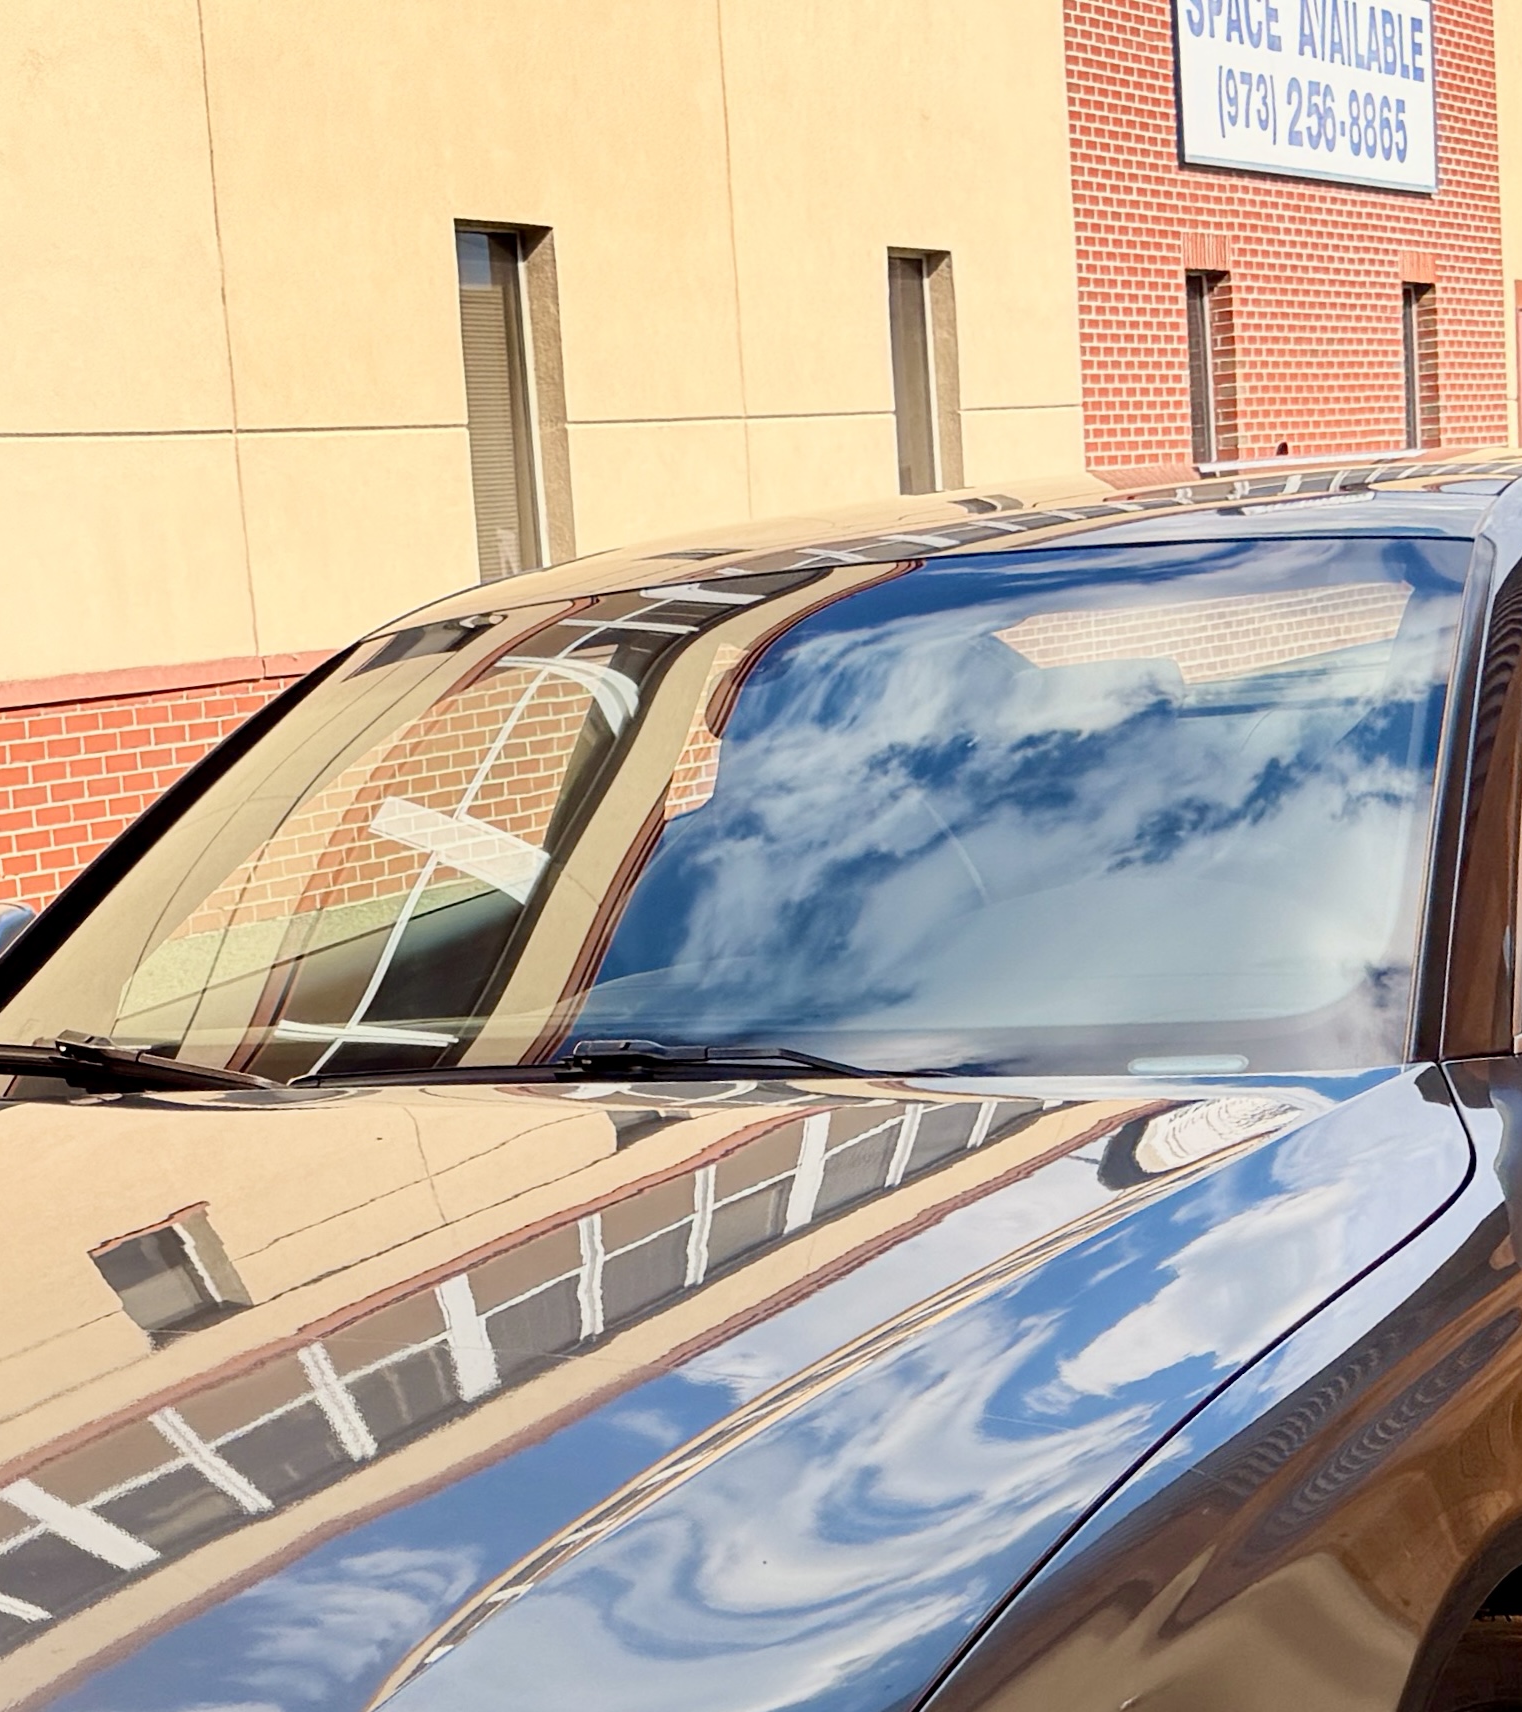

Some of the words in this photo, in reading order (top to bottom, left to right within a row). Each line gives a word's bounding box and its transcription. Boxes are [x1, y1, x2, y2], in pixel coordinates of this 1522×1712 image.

[1298, 0, 1425, 82] AVAILABLE
[1218, 65, 1277, 146] (973)
[1286, 77, 1408, 163] 256-8865
